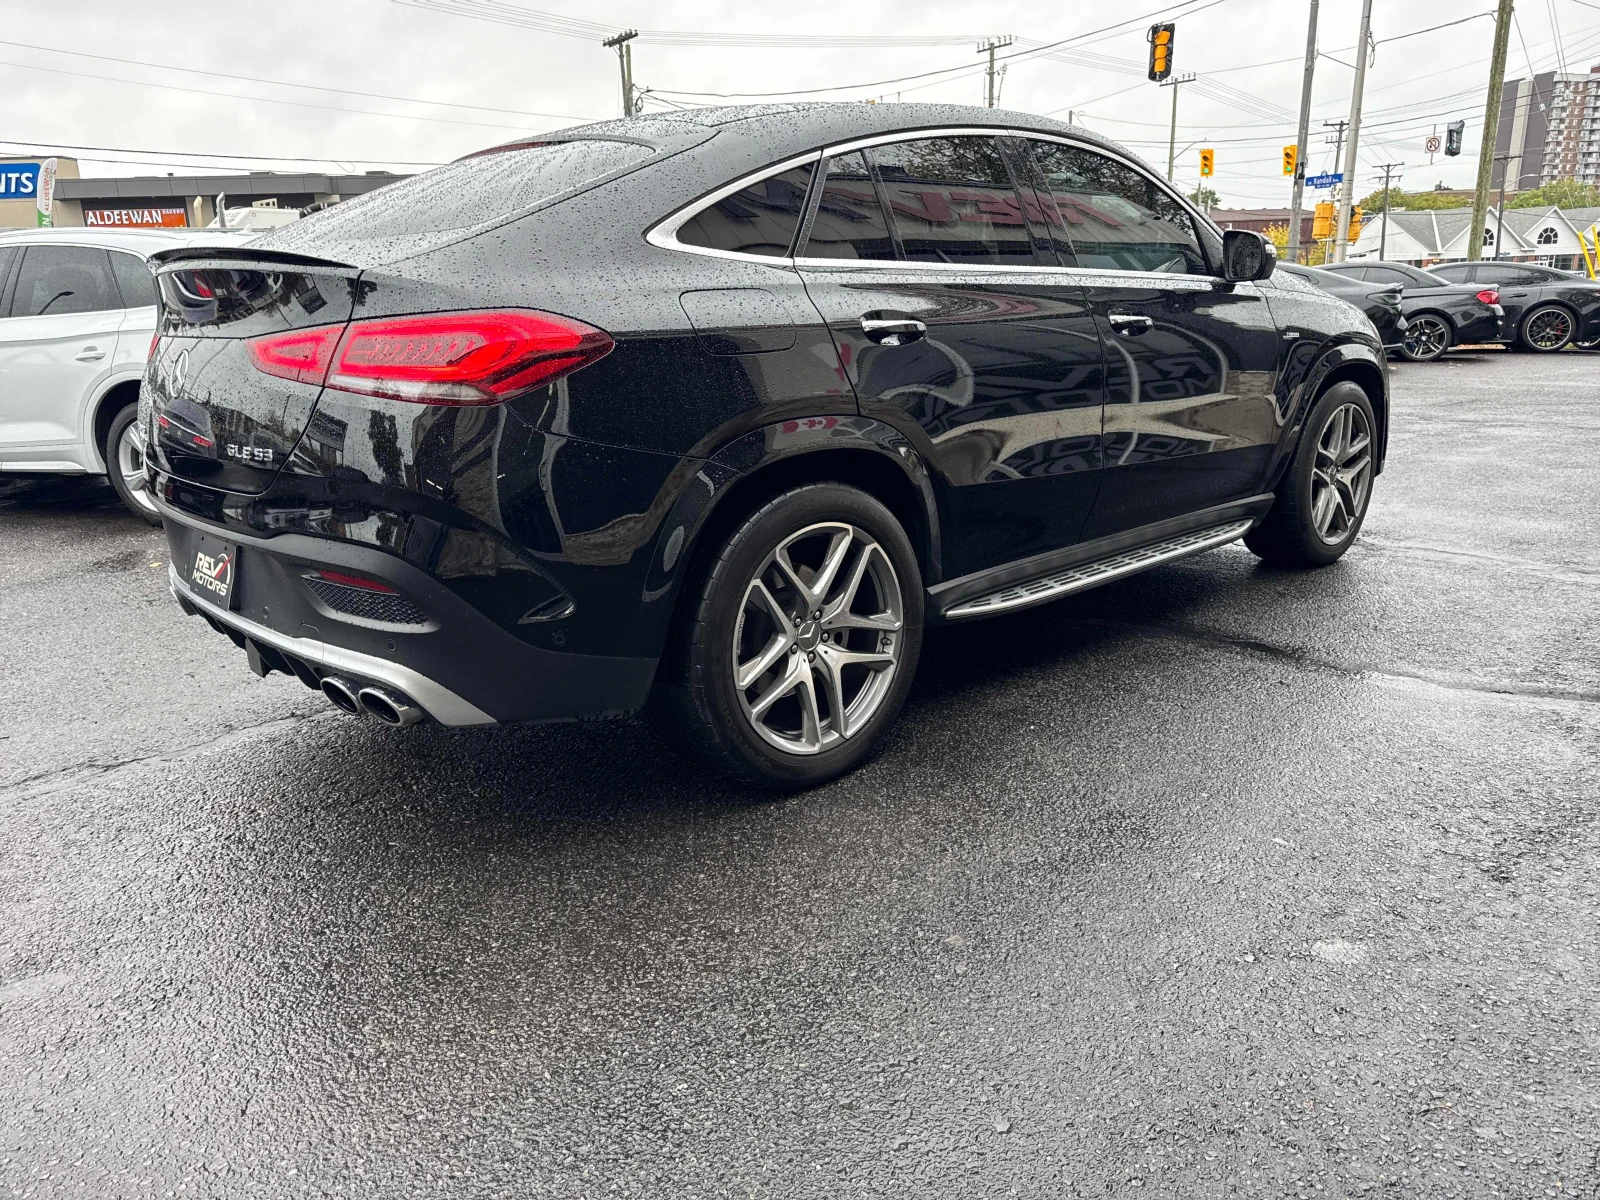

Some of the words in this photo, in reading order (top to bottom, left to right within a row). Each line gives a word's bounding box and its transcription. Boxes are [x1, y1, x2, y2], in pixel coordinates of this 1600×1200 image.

[87, 209, 162, 225] ALDEEWAN
[226, 443, 252, 458] GLE
[254, 447, 273, 461] 53
[195, 551, 224, 578] REV
[192, 568, 229, 597] MOTORS
